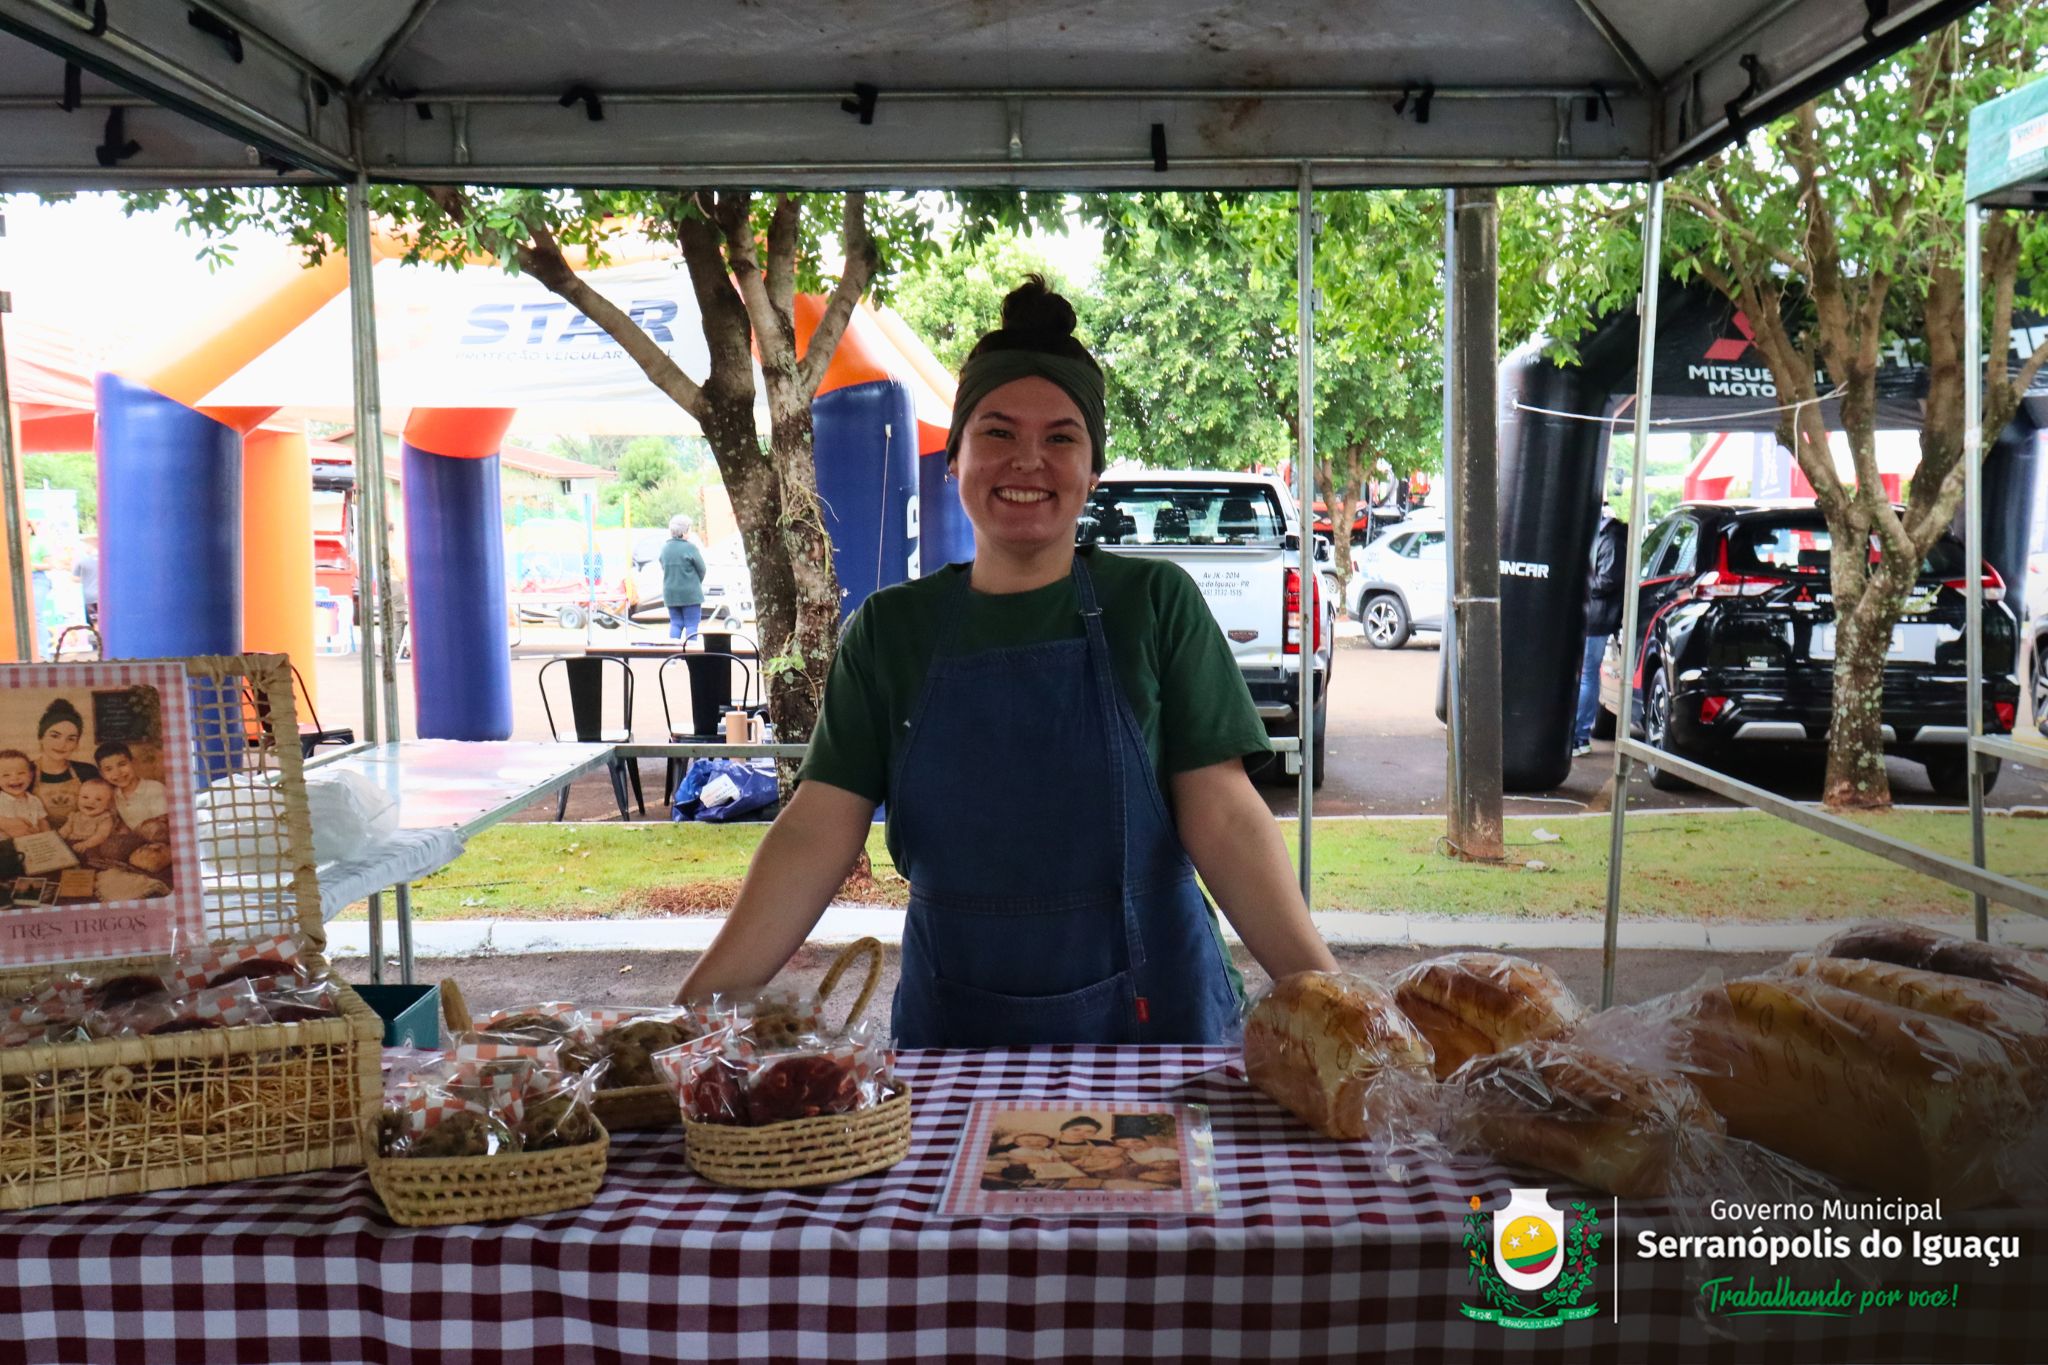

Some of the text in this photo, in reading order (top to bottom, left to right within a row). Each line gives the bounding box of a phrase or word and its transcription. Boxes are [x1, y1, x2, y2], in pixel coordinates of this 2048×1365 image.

[460, 300, 679, 345] STAR
[1708, 381, 1777, 398] MOTO
[71, 915, 148, 934] TRIGOS
